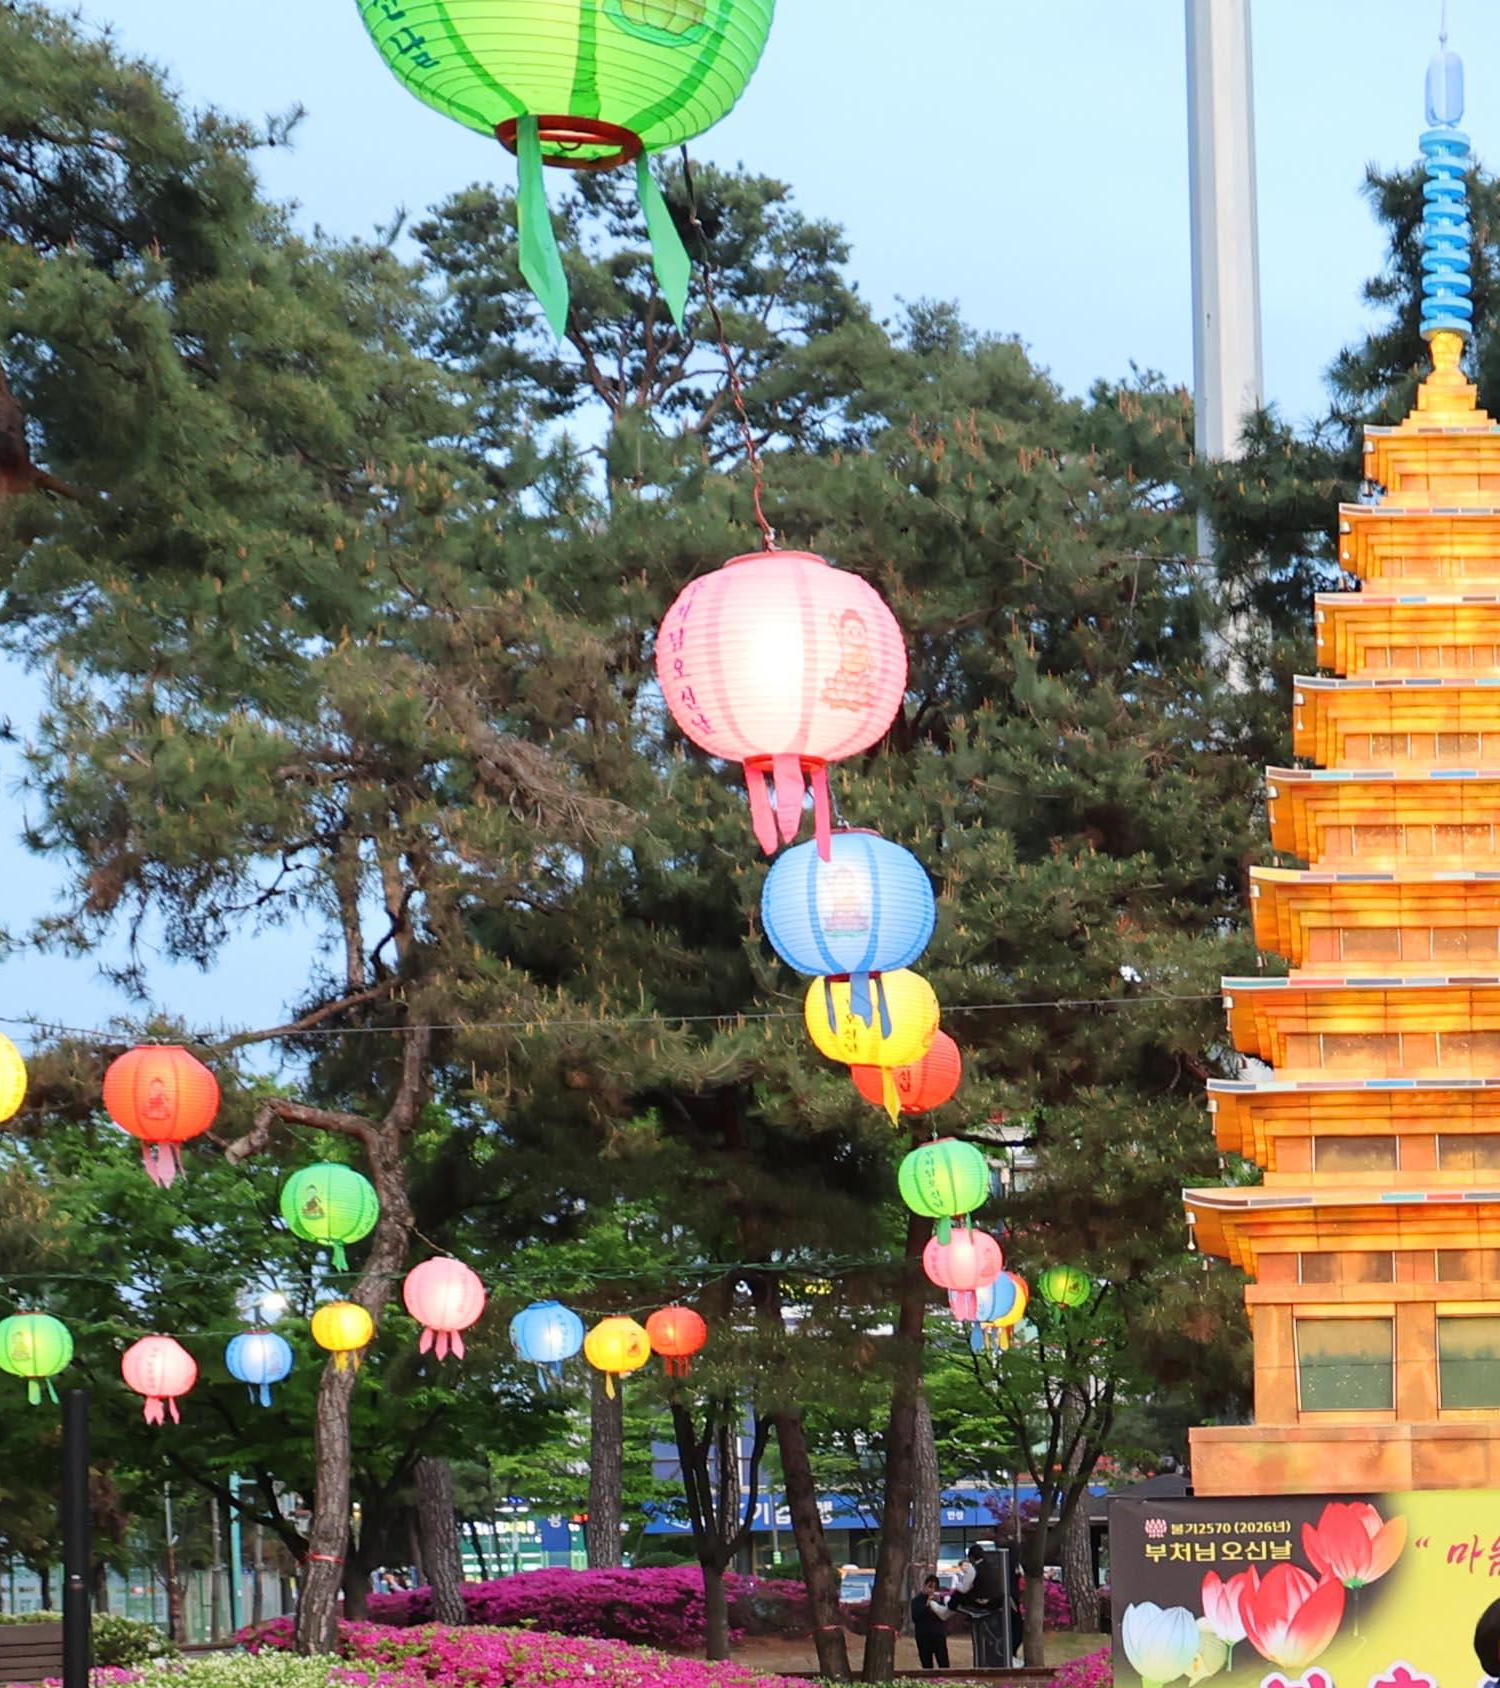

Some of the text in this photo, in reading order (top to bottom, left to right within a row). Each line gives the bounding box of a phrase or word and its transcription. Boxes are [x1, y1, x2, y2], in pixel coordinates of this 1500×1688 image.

[1171, 1520, 1292, 1536] 불기2570 (2026년)
[1145, 1540, 1293, 1563] 부처님 오신날
